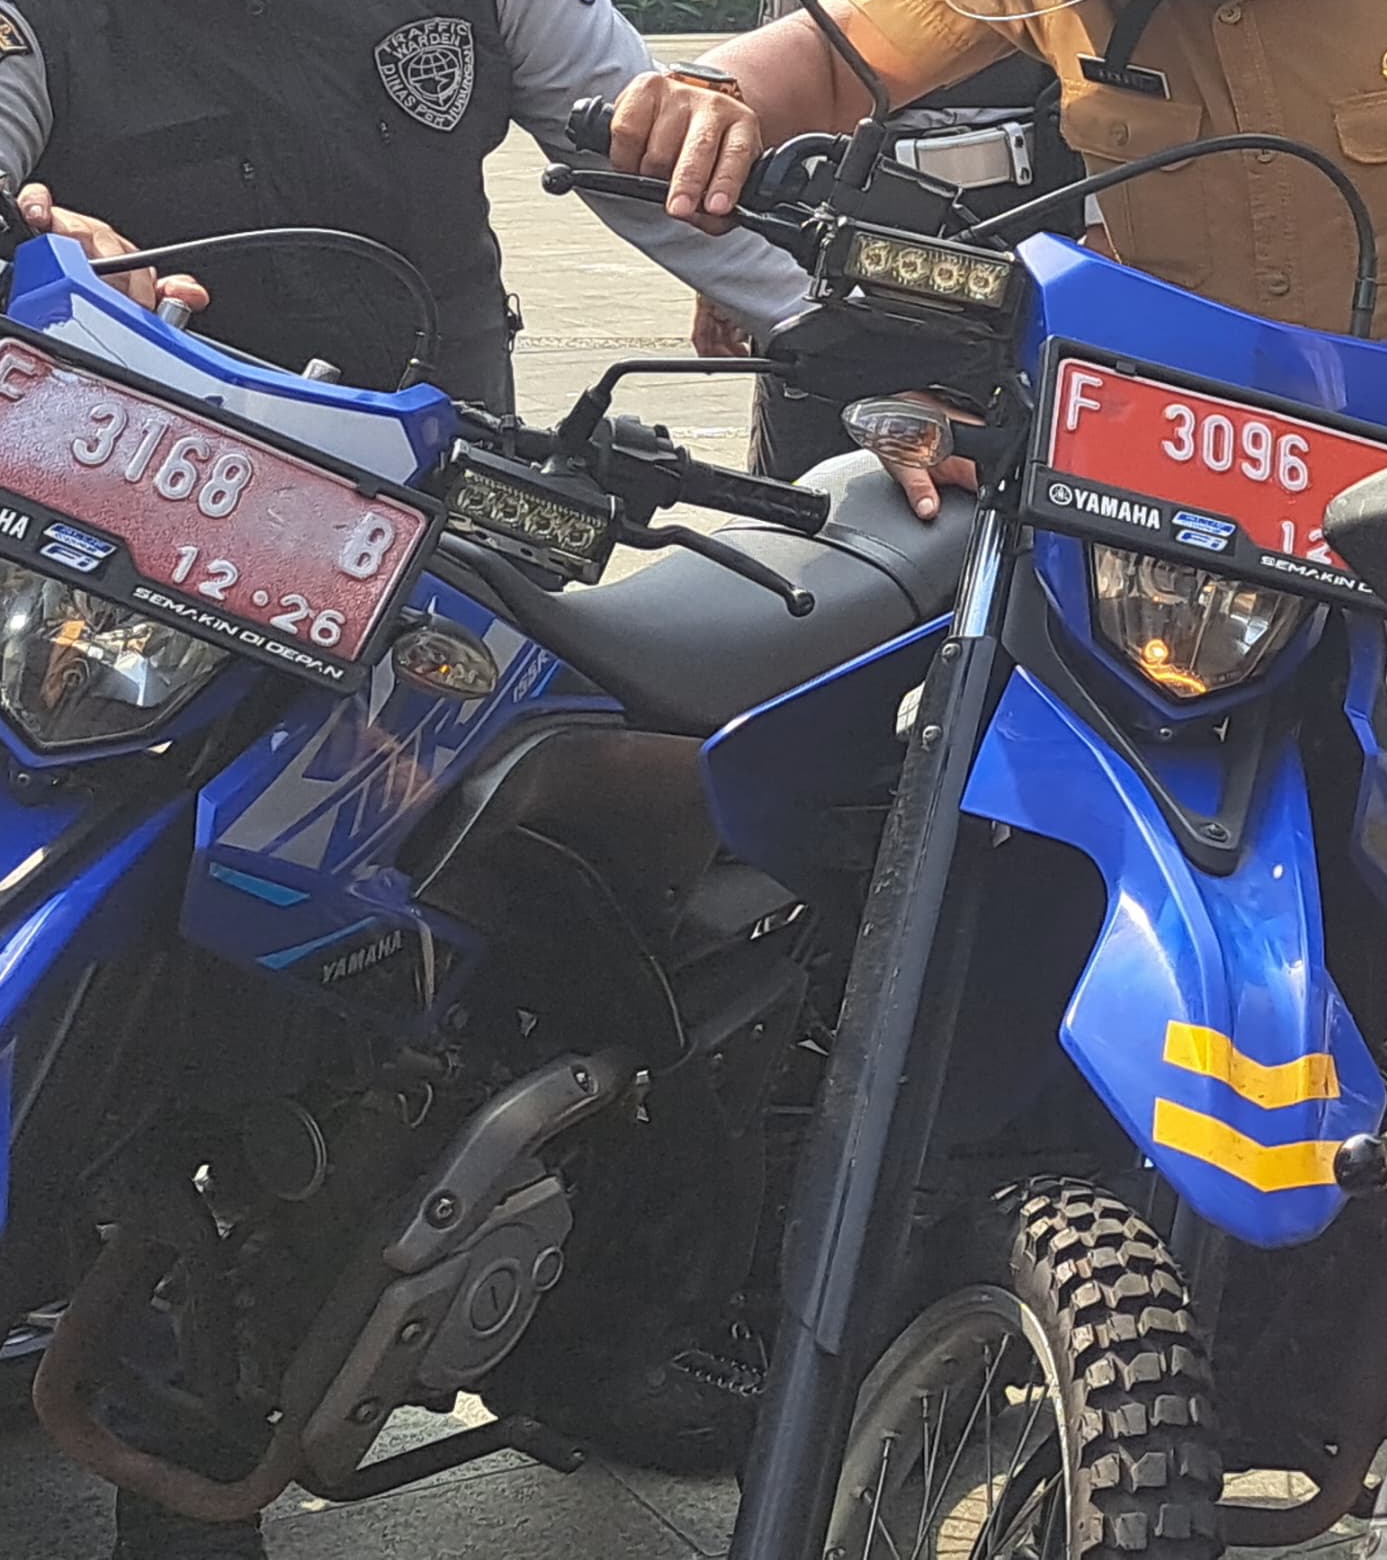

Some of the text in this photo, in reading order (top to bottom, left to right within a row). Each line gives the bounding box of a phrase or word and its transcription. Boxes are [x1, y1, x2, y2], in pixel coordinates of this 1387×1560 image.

[382, 22, 467, 54] TRAFFIC
[392, 33, 460, 59] WARDEN
[1065, 371, 1311, 493] F 3096
[72, 400, 253, 519] 3168
[1074, 488, 1162, 531] YAMAHA
[1260, 555, 1356, 589] SEMAKIN
[133, 587, 344, 679] SEMAKIN DI DEPAN
[322, 929, 402, 984] YAMAHA
